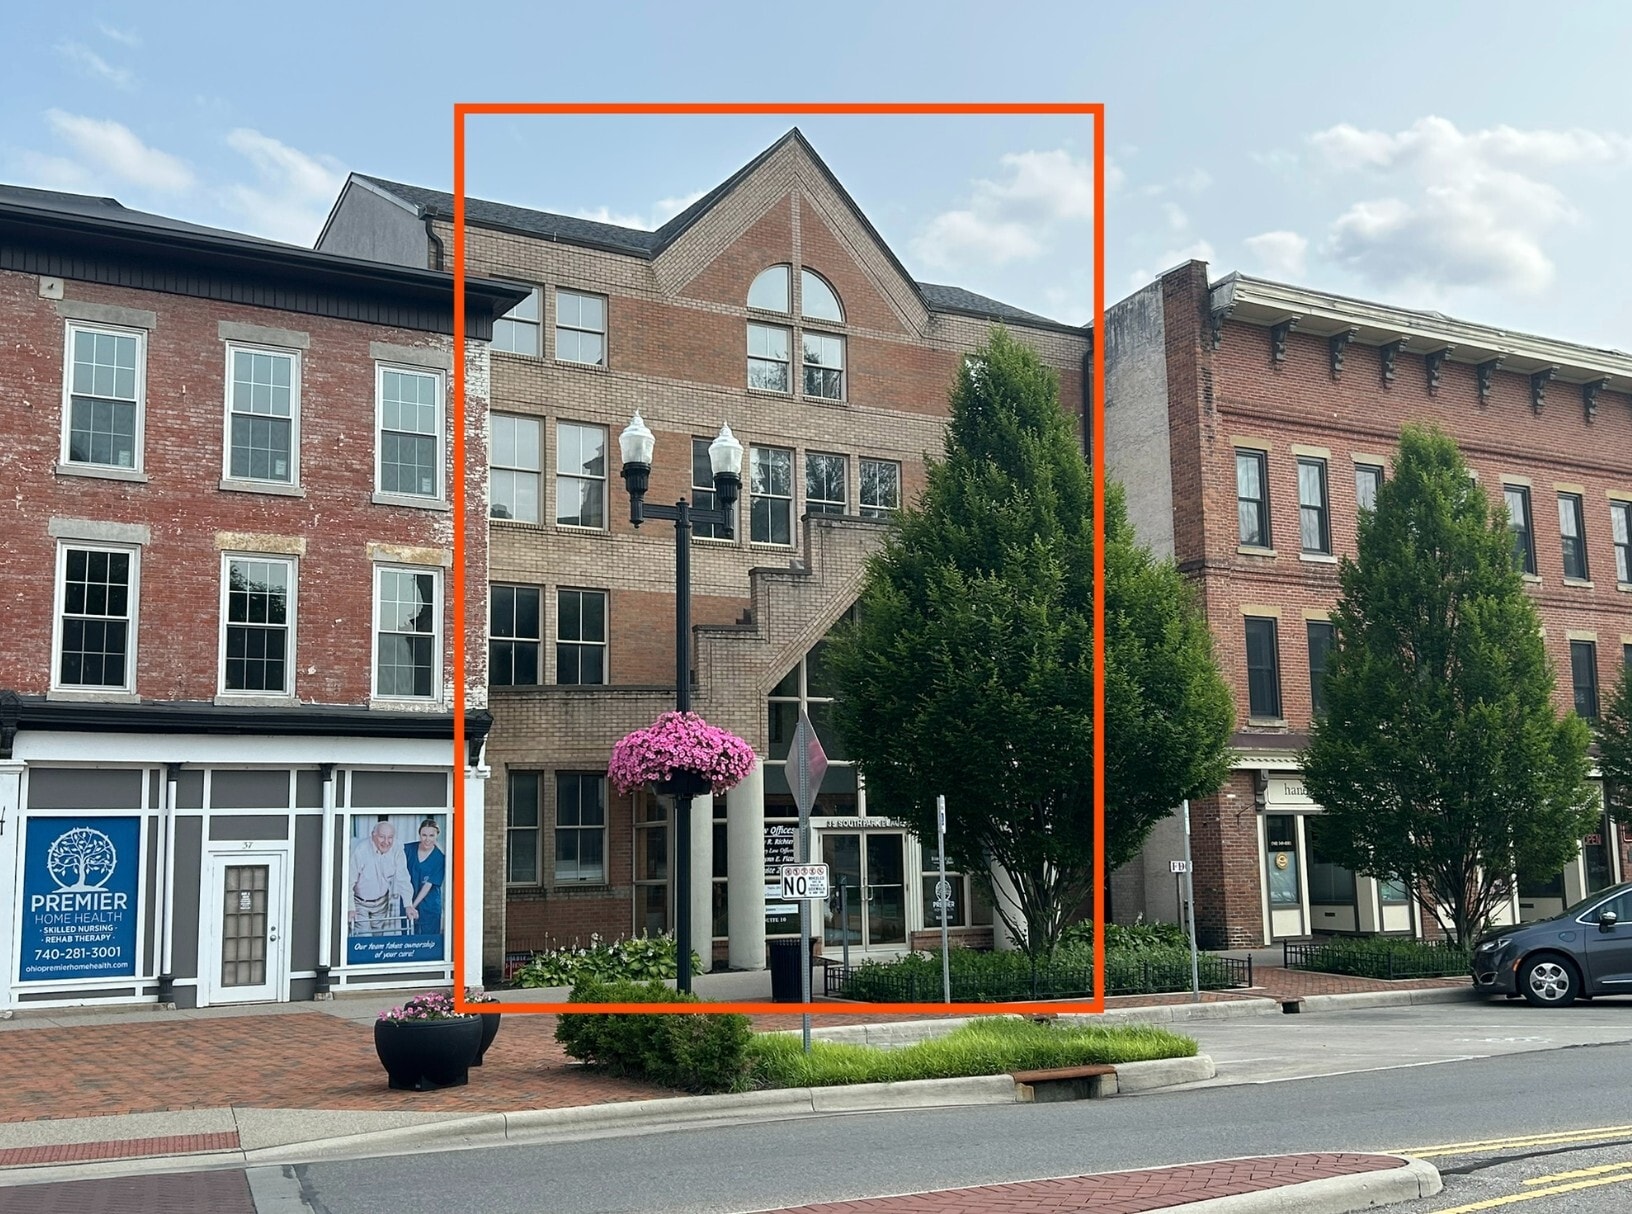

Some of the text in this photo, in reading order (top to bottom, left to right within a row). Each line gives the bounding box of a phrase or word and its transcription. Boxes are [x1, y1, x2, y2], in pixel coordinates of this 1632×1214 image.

[242, 841, 254, 849] 37
[784, 876, 807, 896] NO
[31, 892, 128, 912] PREMIER
[35, 911, 122, 925] HOME HEALTH
[43, 924, 114, 934] SKILLED NURSING
[45, 934, 111, 943] REHAB THERAPY
[354, 940, 436, 951] Our team takes ownership
[34, 946, 121, 960] 740-281-3001
[374, 949, 415, 960] of your care!
[25, 962, 129, 973] ohiopremierhomehealth.com
